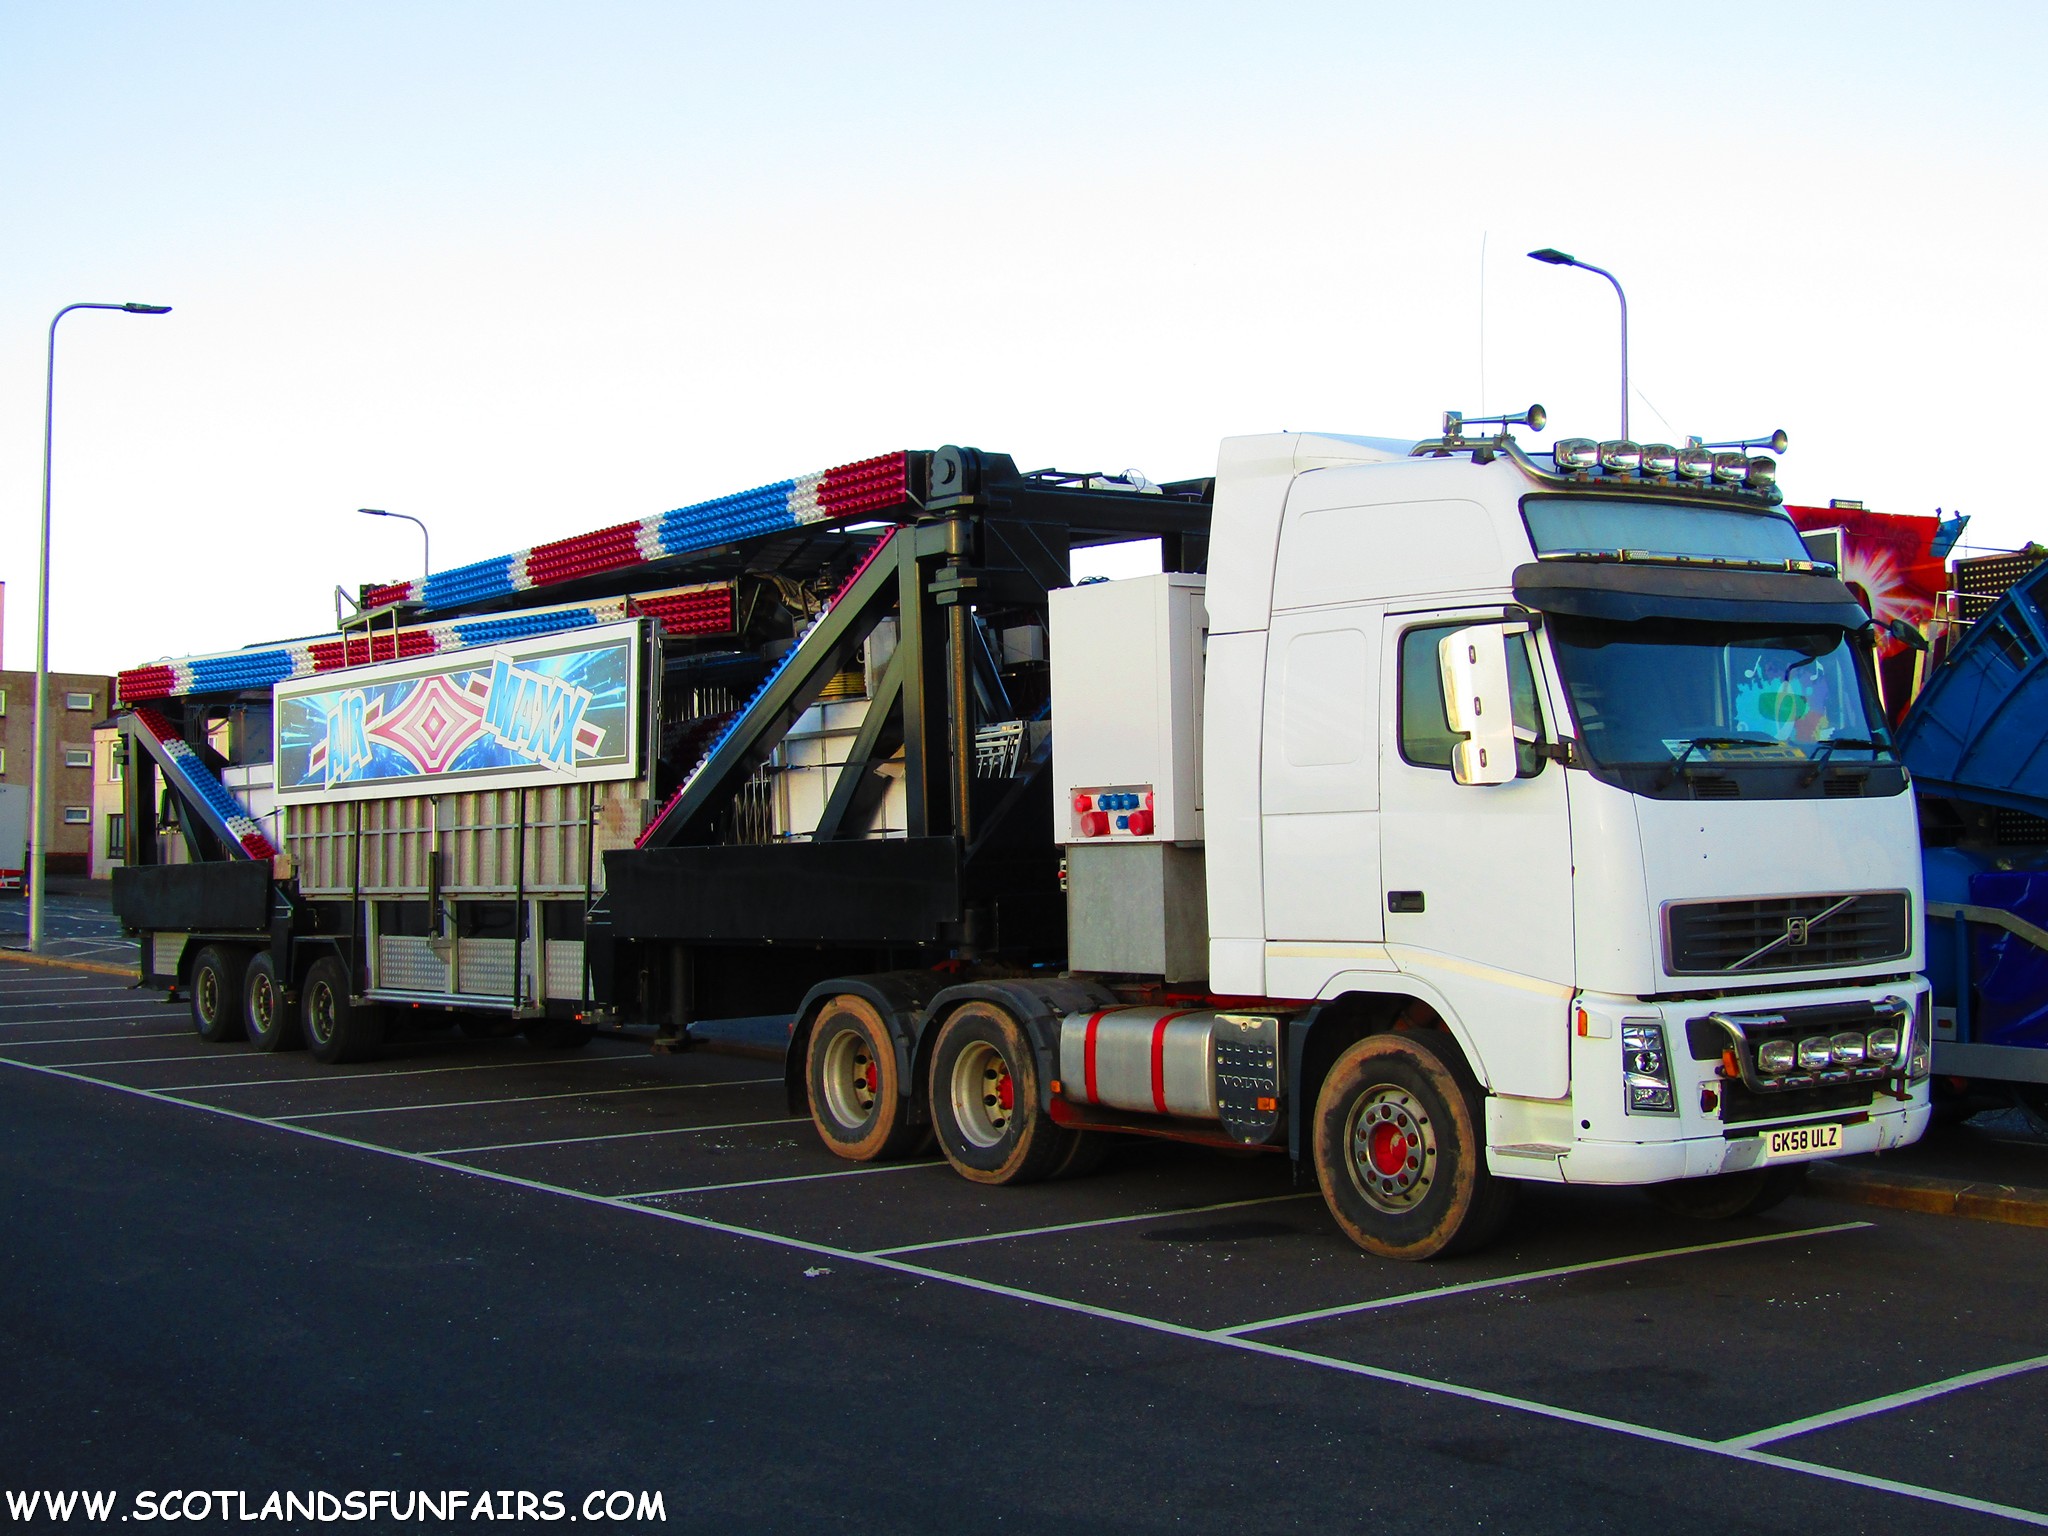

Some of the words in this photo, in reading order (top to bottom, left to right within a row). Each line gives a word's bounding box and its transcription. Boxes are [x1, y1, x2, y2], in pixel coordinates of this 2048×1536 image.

[326, 690, 372, 788] AIR
[483, 655, 592, 771] MAXX
[1772, 1130, 1808, 1152] GK58
[1811, 1127, 1837, 1148] ULZ
